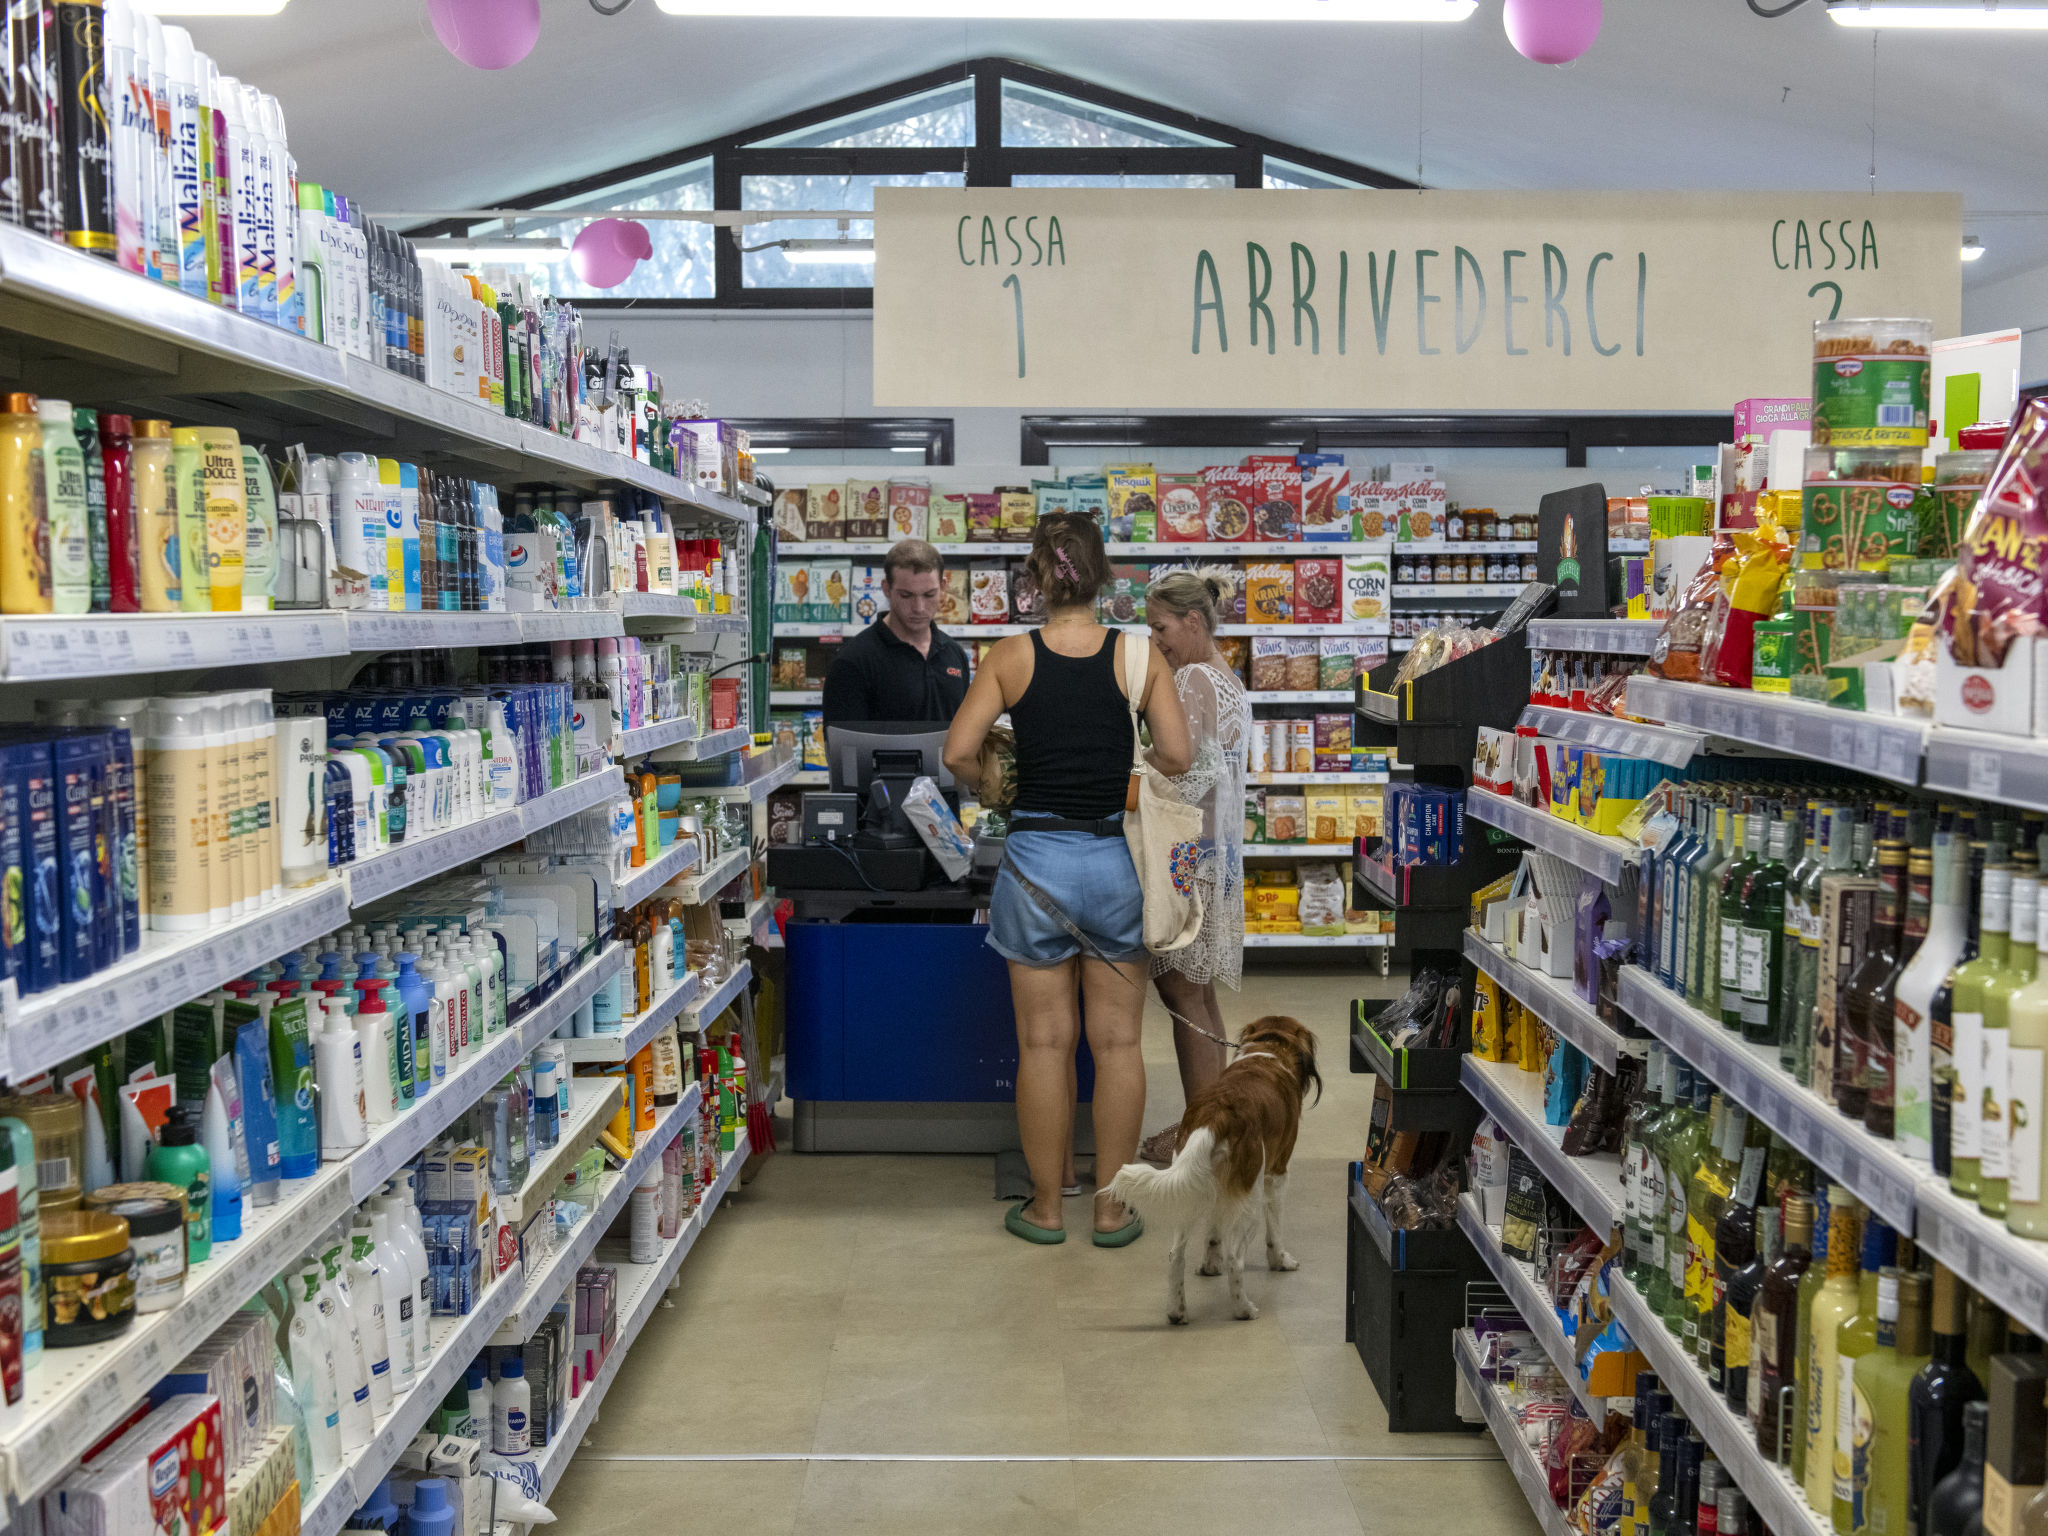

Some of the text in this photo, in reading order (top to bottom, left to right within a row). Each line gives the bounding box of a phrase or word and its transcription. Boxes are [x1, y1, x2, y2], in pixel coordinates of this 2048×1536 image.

[173, 121, 200, 232] Malizia
[238, 175, 258, 269] Malizia
[257, 182, 276, 275] Malizia
[958, 216, 1066, 268] CASSA
[1772, 219, 1878, 271] CASSA
[1191, 241, 1646, 357] ARRIVEDERCI
[1001, 274, 1027, 378] 1
[1755, 414, 1779, 424] GIOCA
[1781, 412, 1799, 422] ALLA
[205, 455, 234, 468] Ultra
[204, 467, 237, 480] DOLCE
[245, 477, 258, 486] tra
[1113, 476, 1151, 488] Nesquik
[245, 486, 261, 496] LCE
[1162, 502, 1200, 515] Cheerios
[1347, 577, 1386, 590] CORN
[1254, 586, 1285, 601] KRAVE
[1354, 589, 1380, 597] Flakes
[276, 704, 290, 714] AZ
[303, 704, 317, 713] AZ
[328, 708, 345, 719] AZ
[355, 707, 372, 718] AZ
[382, 706, 399, 718] AZ
[410, 706, 427, 717] AZ
[1456, 802, 1464, 835] CHAMPION
[460, 989, 468, 1047] BOROTALCO
[448, 998, 456, 1057] BOROTALCO
[398, 1021, 411, 1073] VIDAL
[508, 1417, 526, 1425] FARMA
[494, 1470, 540, 1503] Coton
